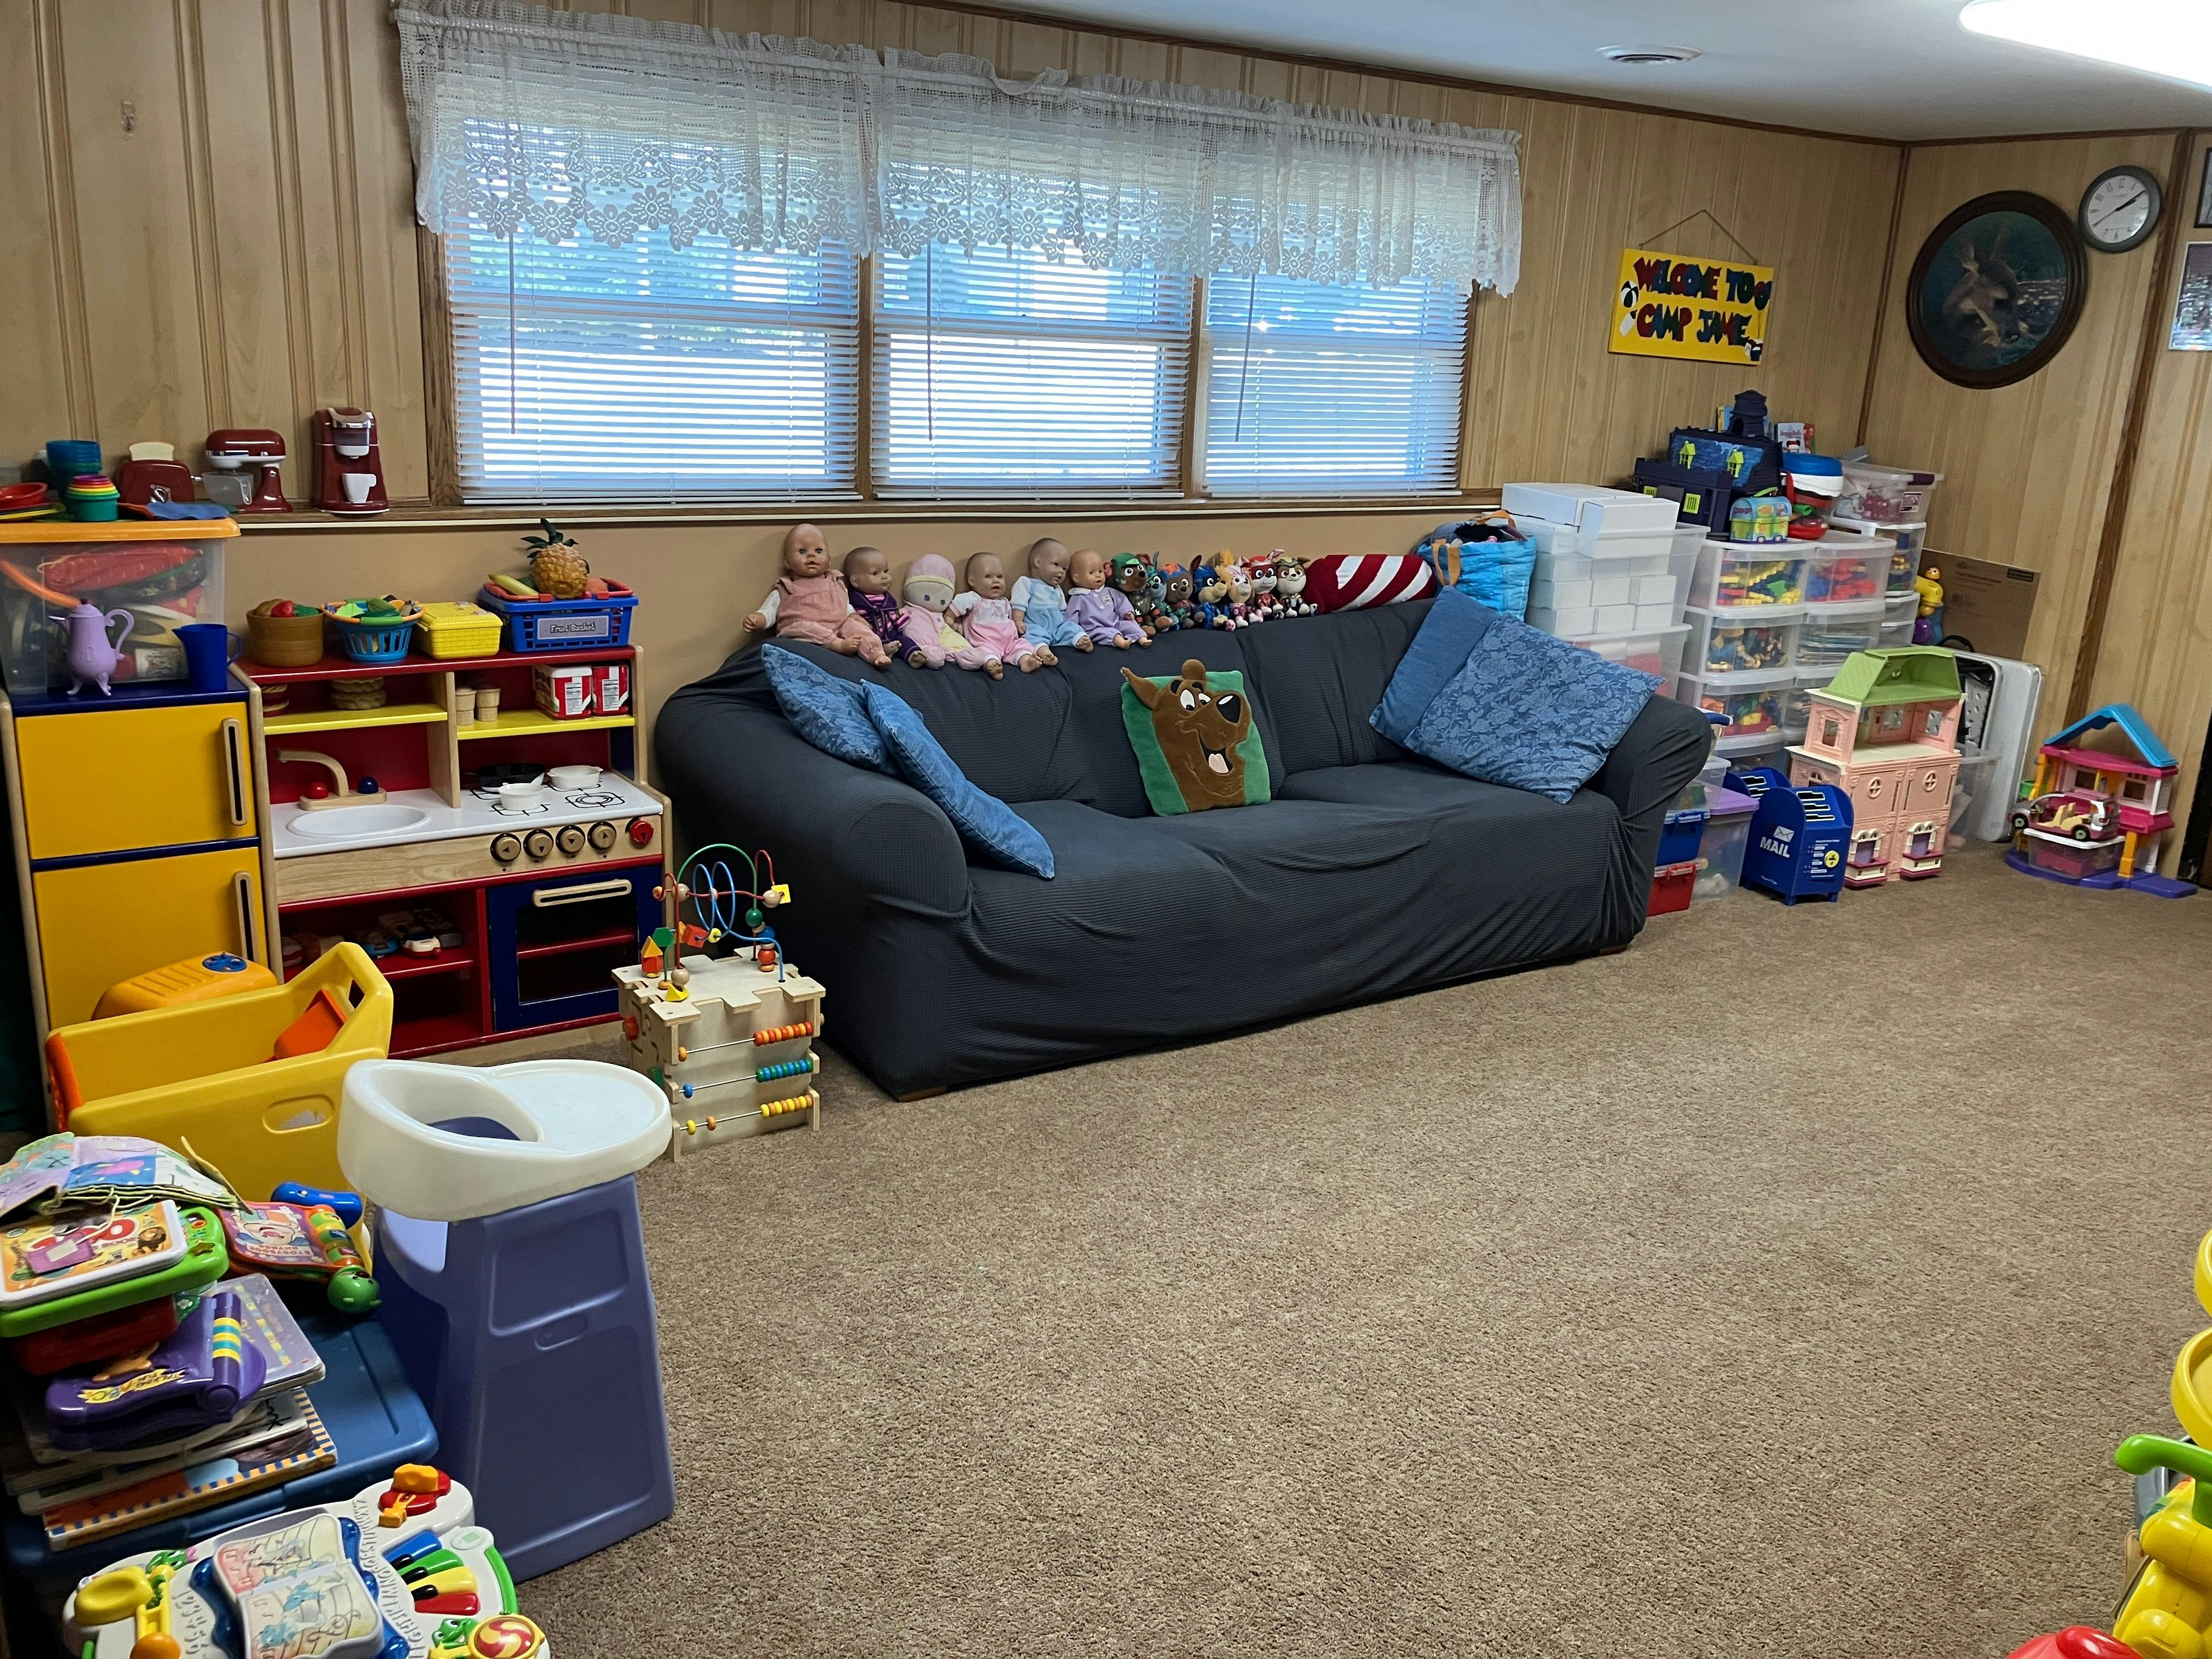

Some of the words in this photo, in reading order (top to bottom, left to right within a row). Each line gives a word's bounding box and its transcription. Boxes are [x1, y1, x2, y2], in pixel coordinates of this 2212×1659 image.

[1725, 268, 1755, 304] TO
[1636, 303, 1693, 342] CAMP
[550, 624, 569, 633] Fruit
[570, 622, 596, 633] Basket
[1759, 836, 1791, 859] MAIL
